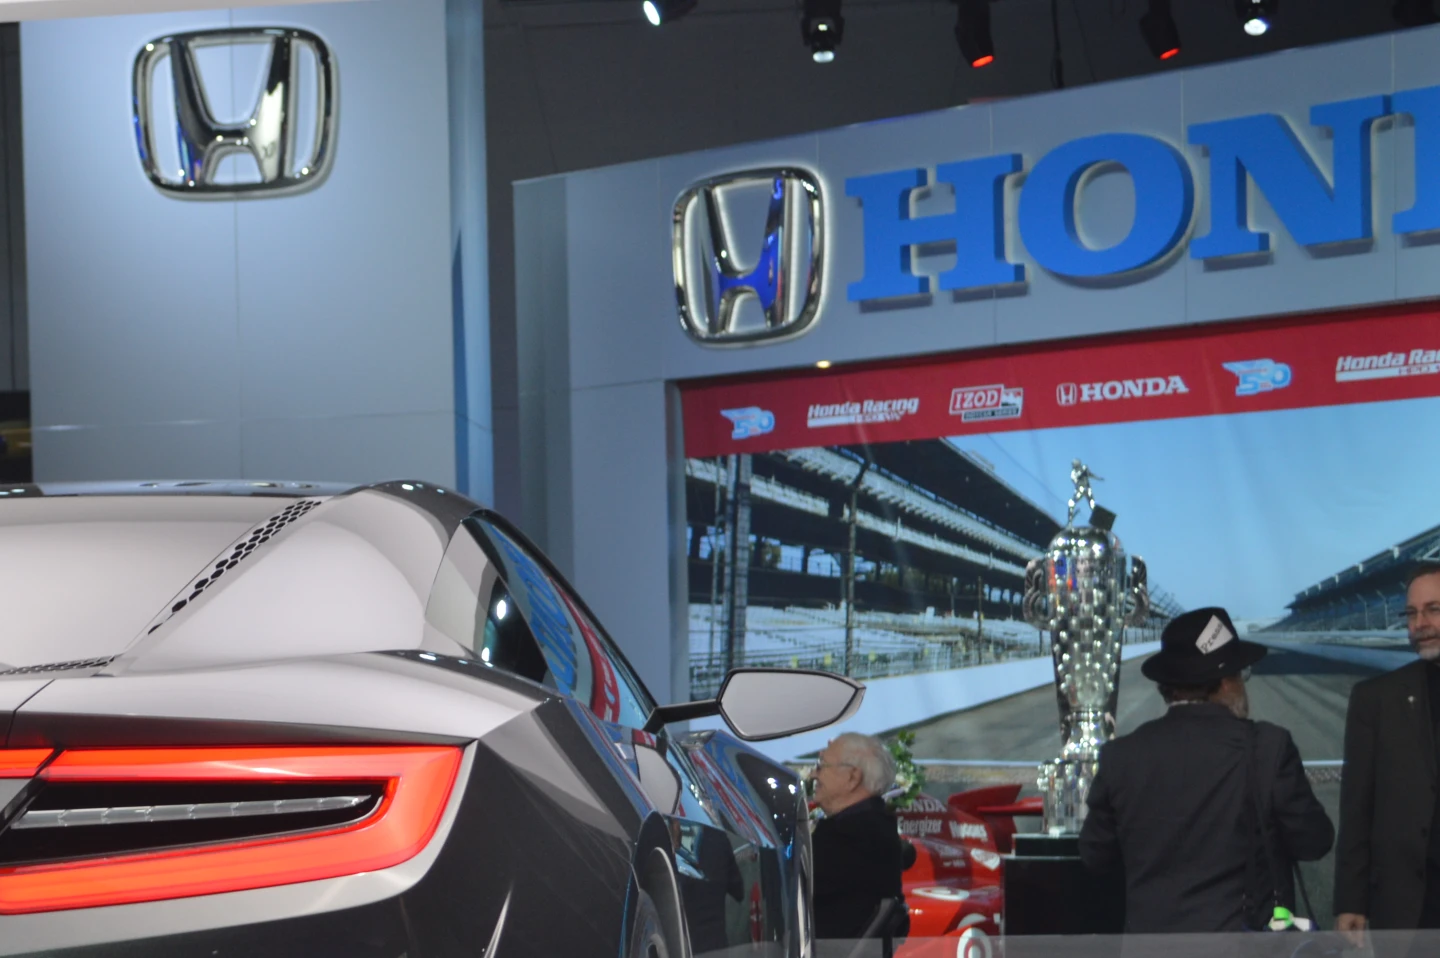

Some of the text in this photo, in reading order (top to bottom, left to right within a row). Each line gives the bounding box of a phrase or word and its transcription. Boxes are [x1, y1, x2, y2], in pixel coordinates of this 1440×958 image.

[1336, 352, 1406, 371] Honda
[1408, 348, 1440, 364] Ra
[954, 389, 999, 410] IZOD
[1080, 375, 1189, 402] HONDA
[807, 401, 860, 418] Honda
[863, 397, 920, 415] Racing
[897, 816, 942, 838] Energizer
